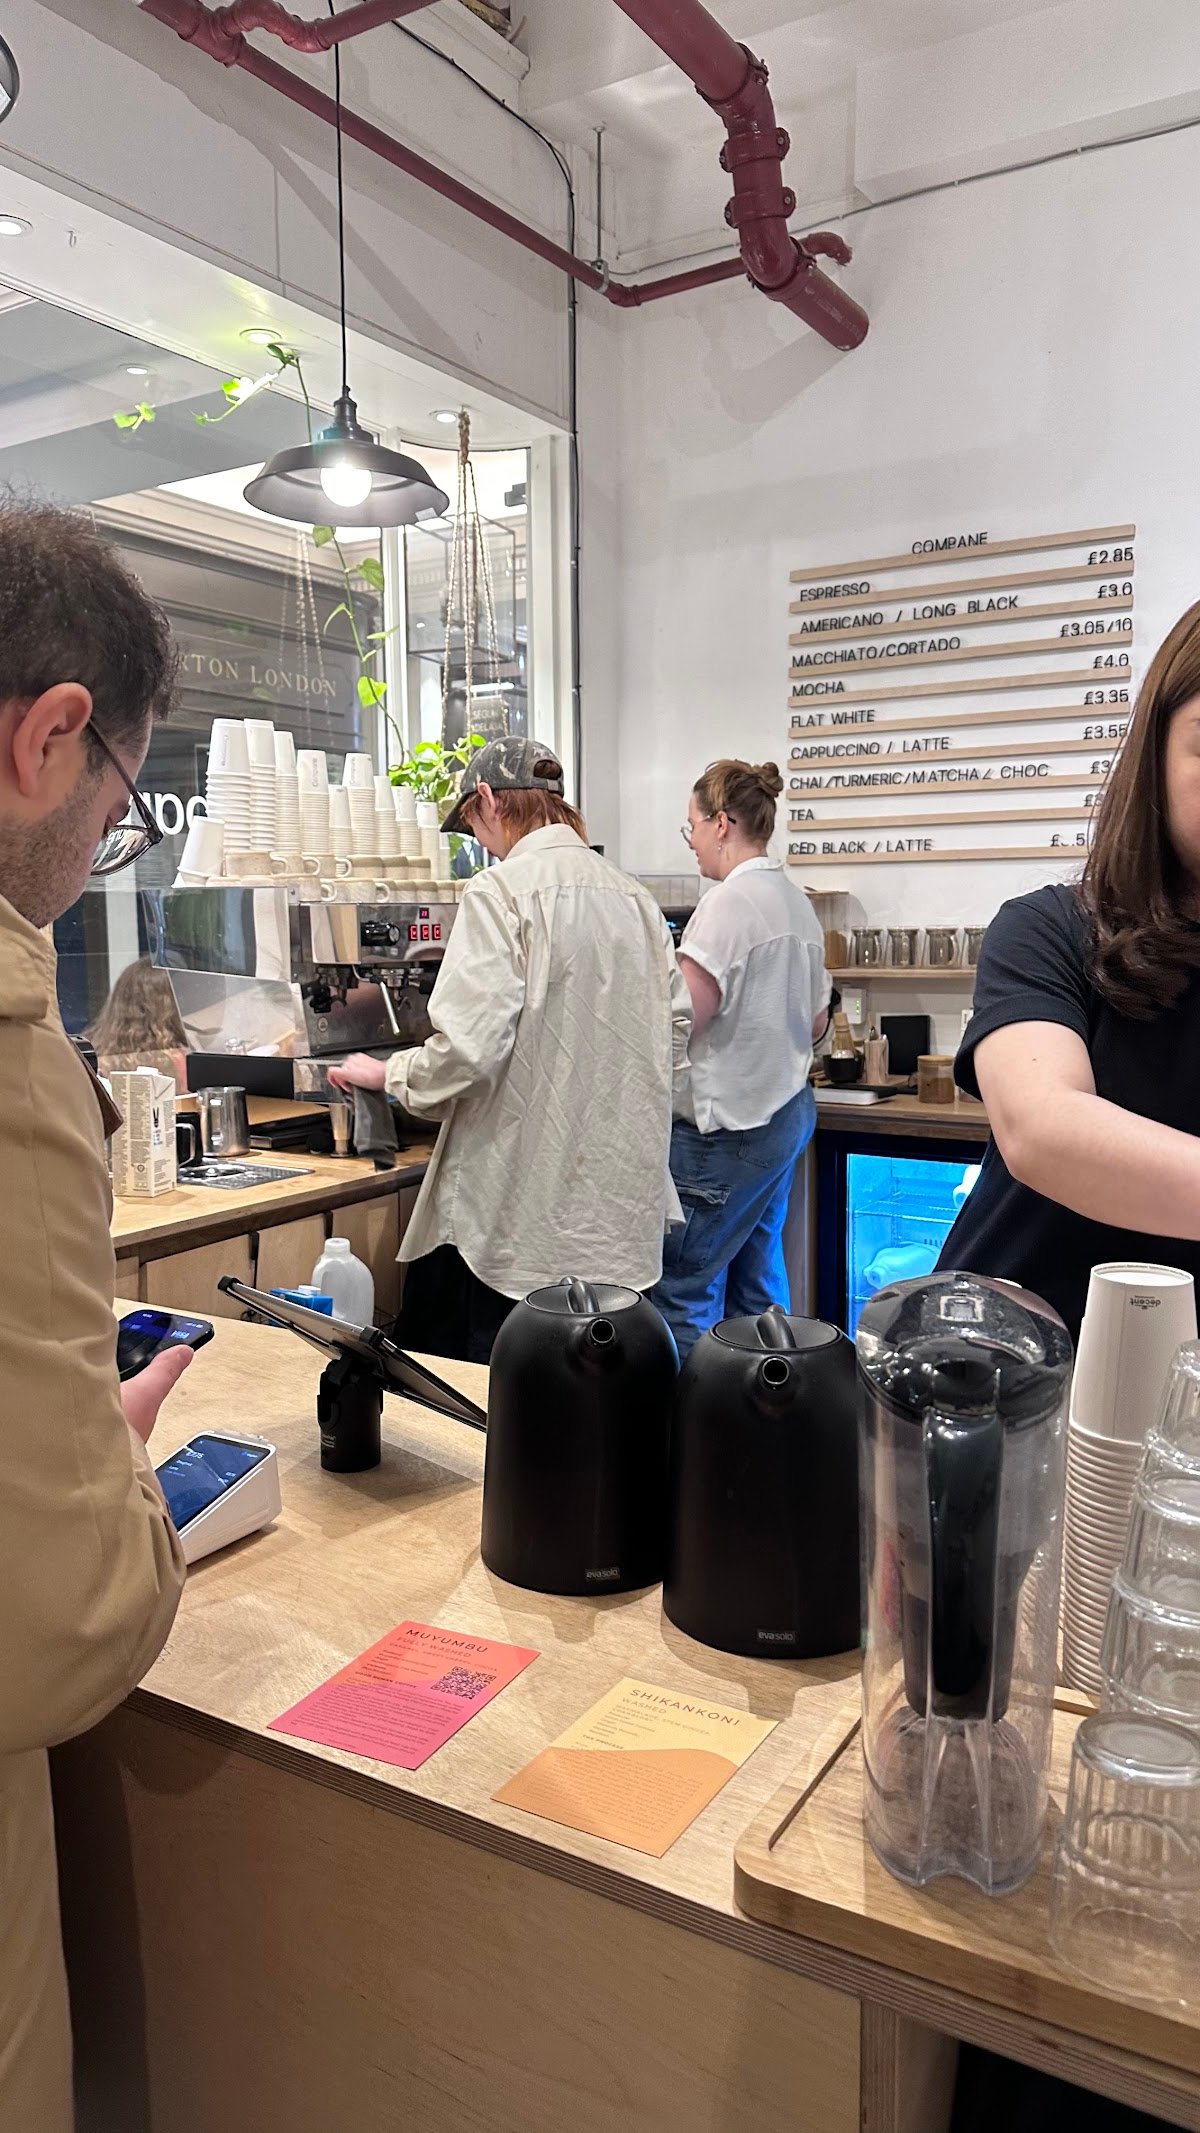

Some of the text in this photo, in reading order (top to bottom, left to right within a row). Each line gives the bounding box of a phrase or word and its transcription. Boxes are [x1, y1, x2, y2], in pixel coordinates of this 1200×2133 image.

[912, 532, 988, 554] COMPANE
[1088, 547, 1133, 566] £2.85
[799, 582, 870, 602] ESPRESSO
[1098, 582, 1133, 599] £3.0
[799, 612, 884, 634] AMERICANO
[913, 603, 956, 621] LONG
[968, 596, 1018, 614] BLACK
[1060, 617, 1132, 638] £3.05/10
[792, 636, 960, 668] MACCHIATO/CORTADO
[1093, 653, 1129, 669] £4.0
[250, 664, 337, 697] LONDON
[792, 681, 845, 697] MOCHA
[1083, 689, 1129, 705] £3.35
[791, 709, 875, 728] FLAT WHITE
[791, 741, 880, 760] CAPPUCCINO
[903, 737, 950, 753] LATTE
[1000, 763, 1049, 779] CHOC
[789, 809, 815, 821] TEA
[788, 842, 816, 855] ICED
[822, 841, 866, 854] BLACK
[886, 839, 933, 852] LATTE
[1130, 1297, 1161, 1307] decent
[405, 1629, 488, 1654] MUYUMBU
[622, 1697, 667, 1714] WASHED
[630, 1689, 740, 1726] SHIKANKONI
